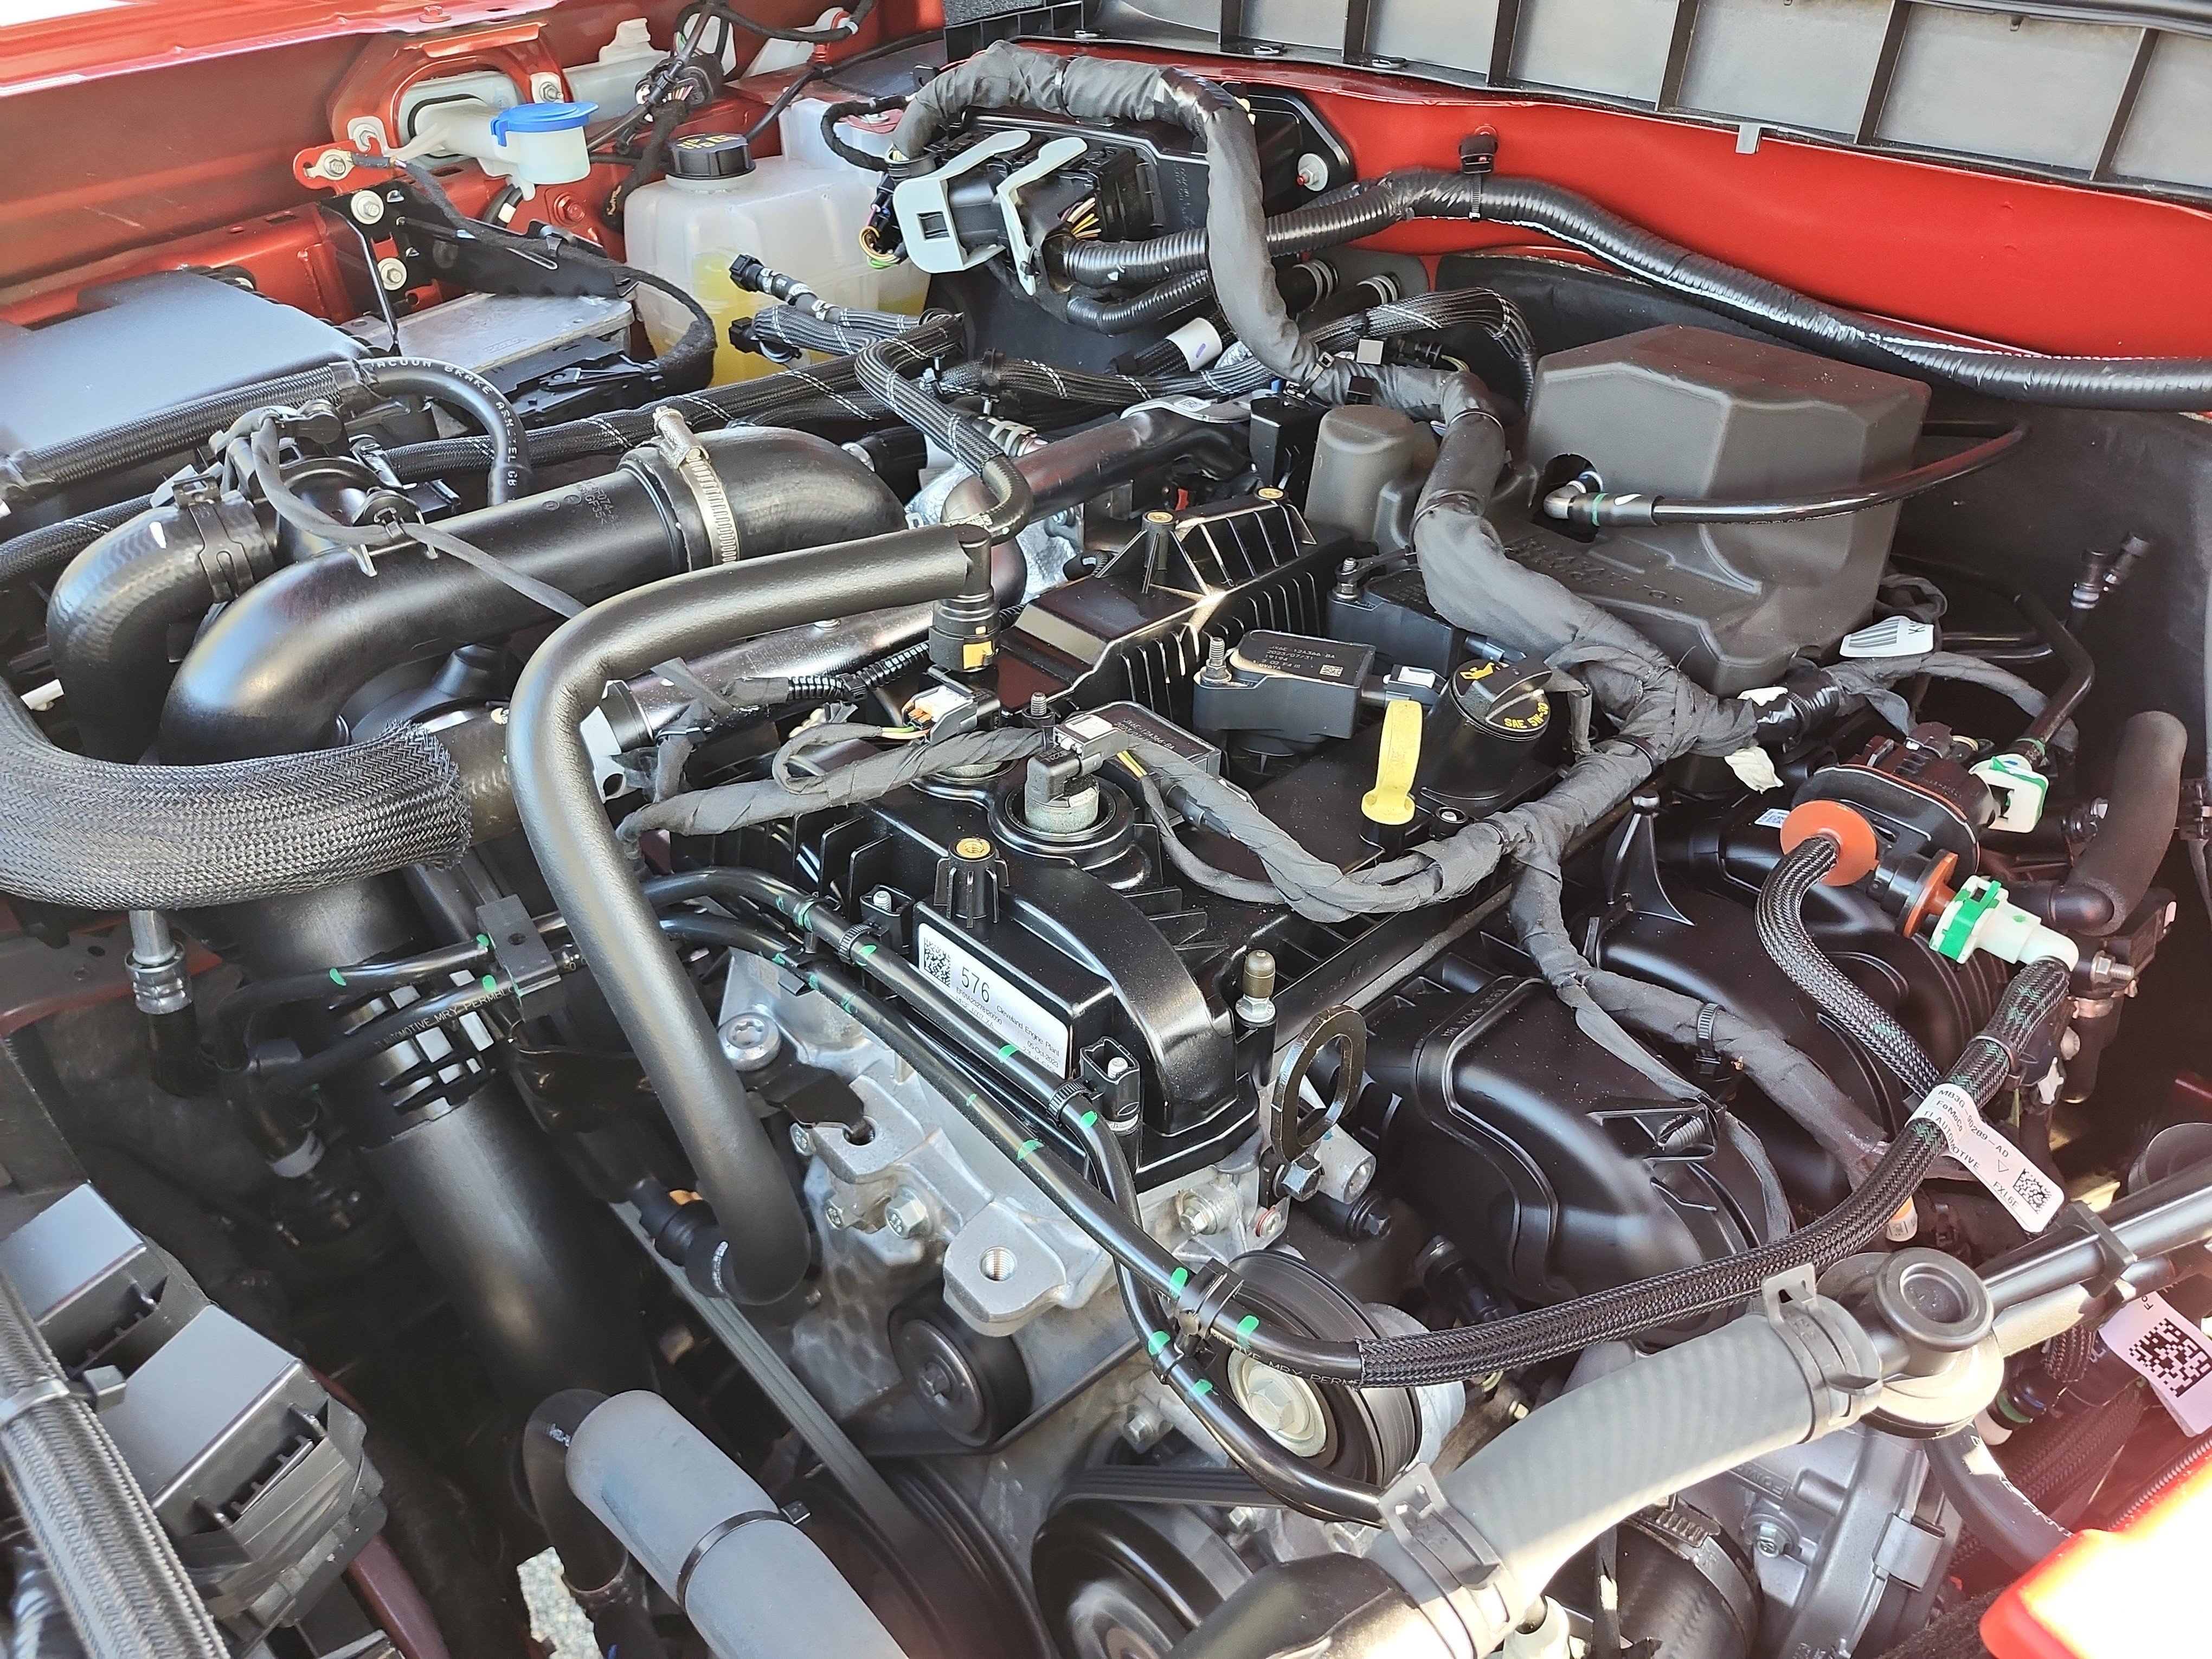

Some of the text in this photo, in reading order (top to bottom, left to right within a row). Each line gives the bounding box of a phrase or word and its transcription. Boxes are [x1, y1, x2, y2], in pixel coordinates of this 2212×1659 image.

[371, 359, 432, 369] ACUUM
[443, 365, 493, 395] BRAKE
[1266, 650, 1313, 660] 2023/07/31
[1504, 702, 1549, 729] SAE 5W-30
[961, 966, 991, 1003] 576
[435, 1006, 459, 1023] MRY
[464, 986, 516, 1011] PERMBLO
[996, 1005, 1023, 1030] Cleveland
[1025, 1027, 1043, 1045] Engine
[1045, 1041, 1060, 1057] Plant
[1027, 1040, 1059, 1069] 05-Oct-2023
[1935, 1099, 1963, 1132] FoMoCo
[1935, 1116, 1980, 1171] AUTOMOTIVE
[2140, 1295, 2154, 1311] FO
[1210, 1327, 1262, 1361] MOTIVE
[1268, 1360, 1303, 1376] MRY
